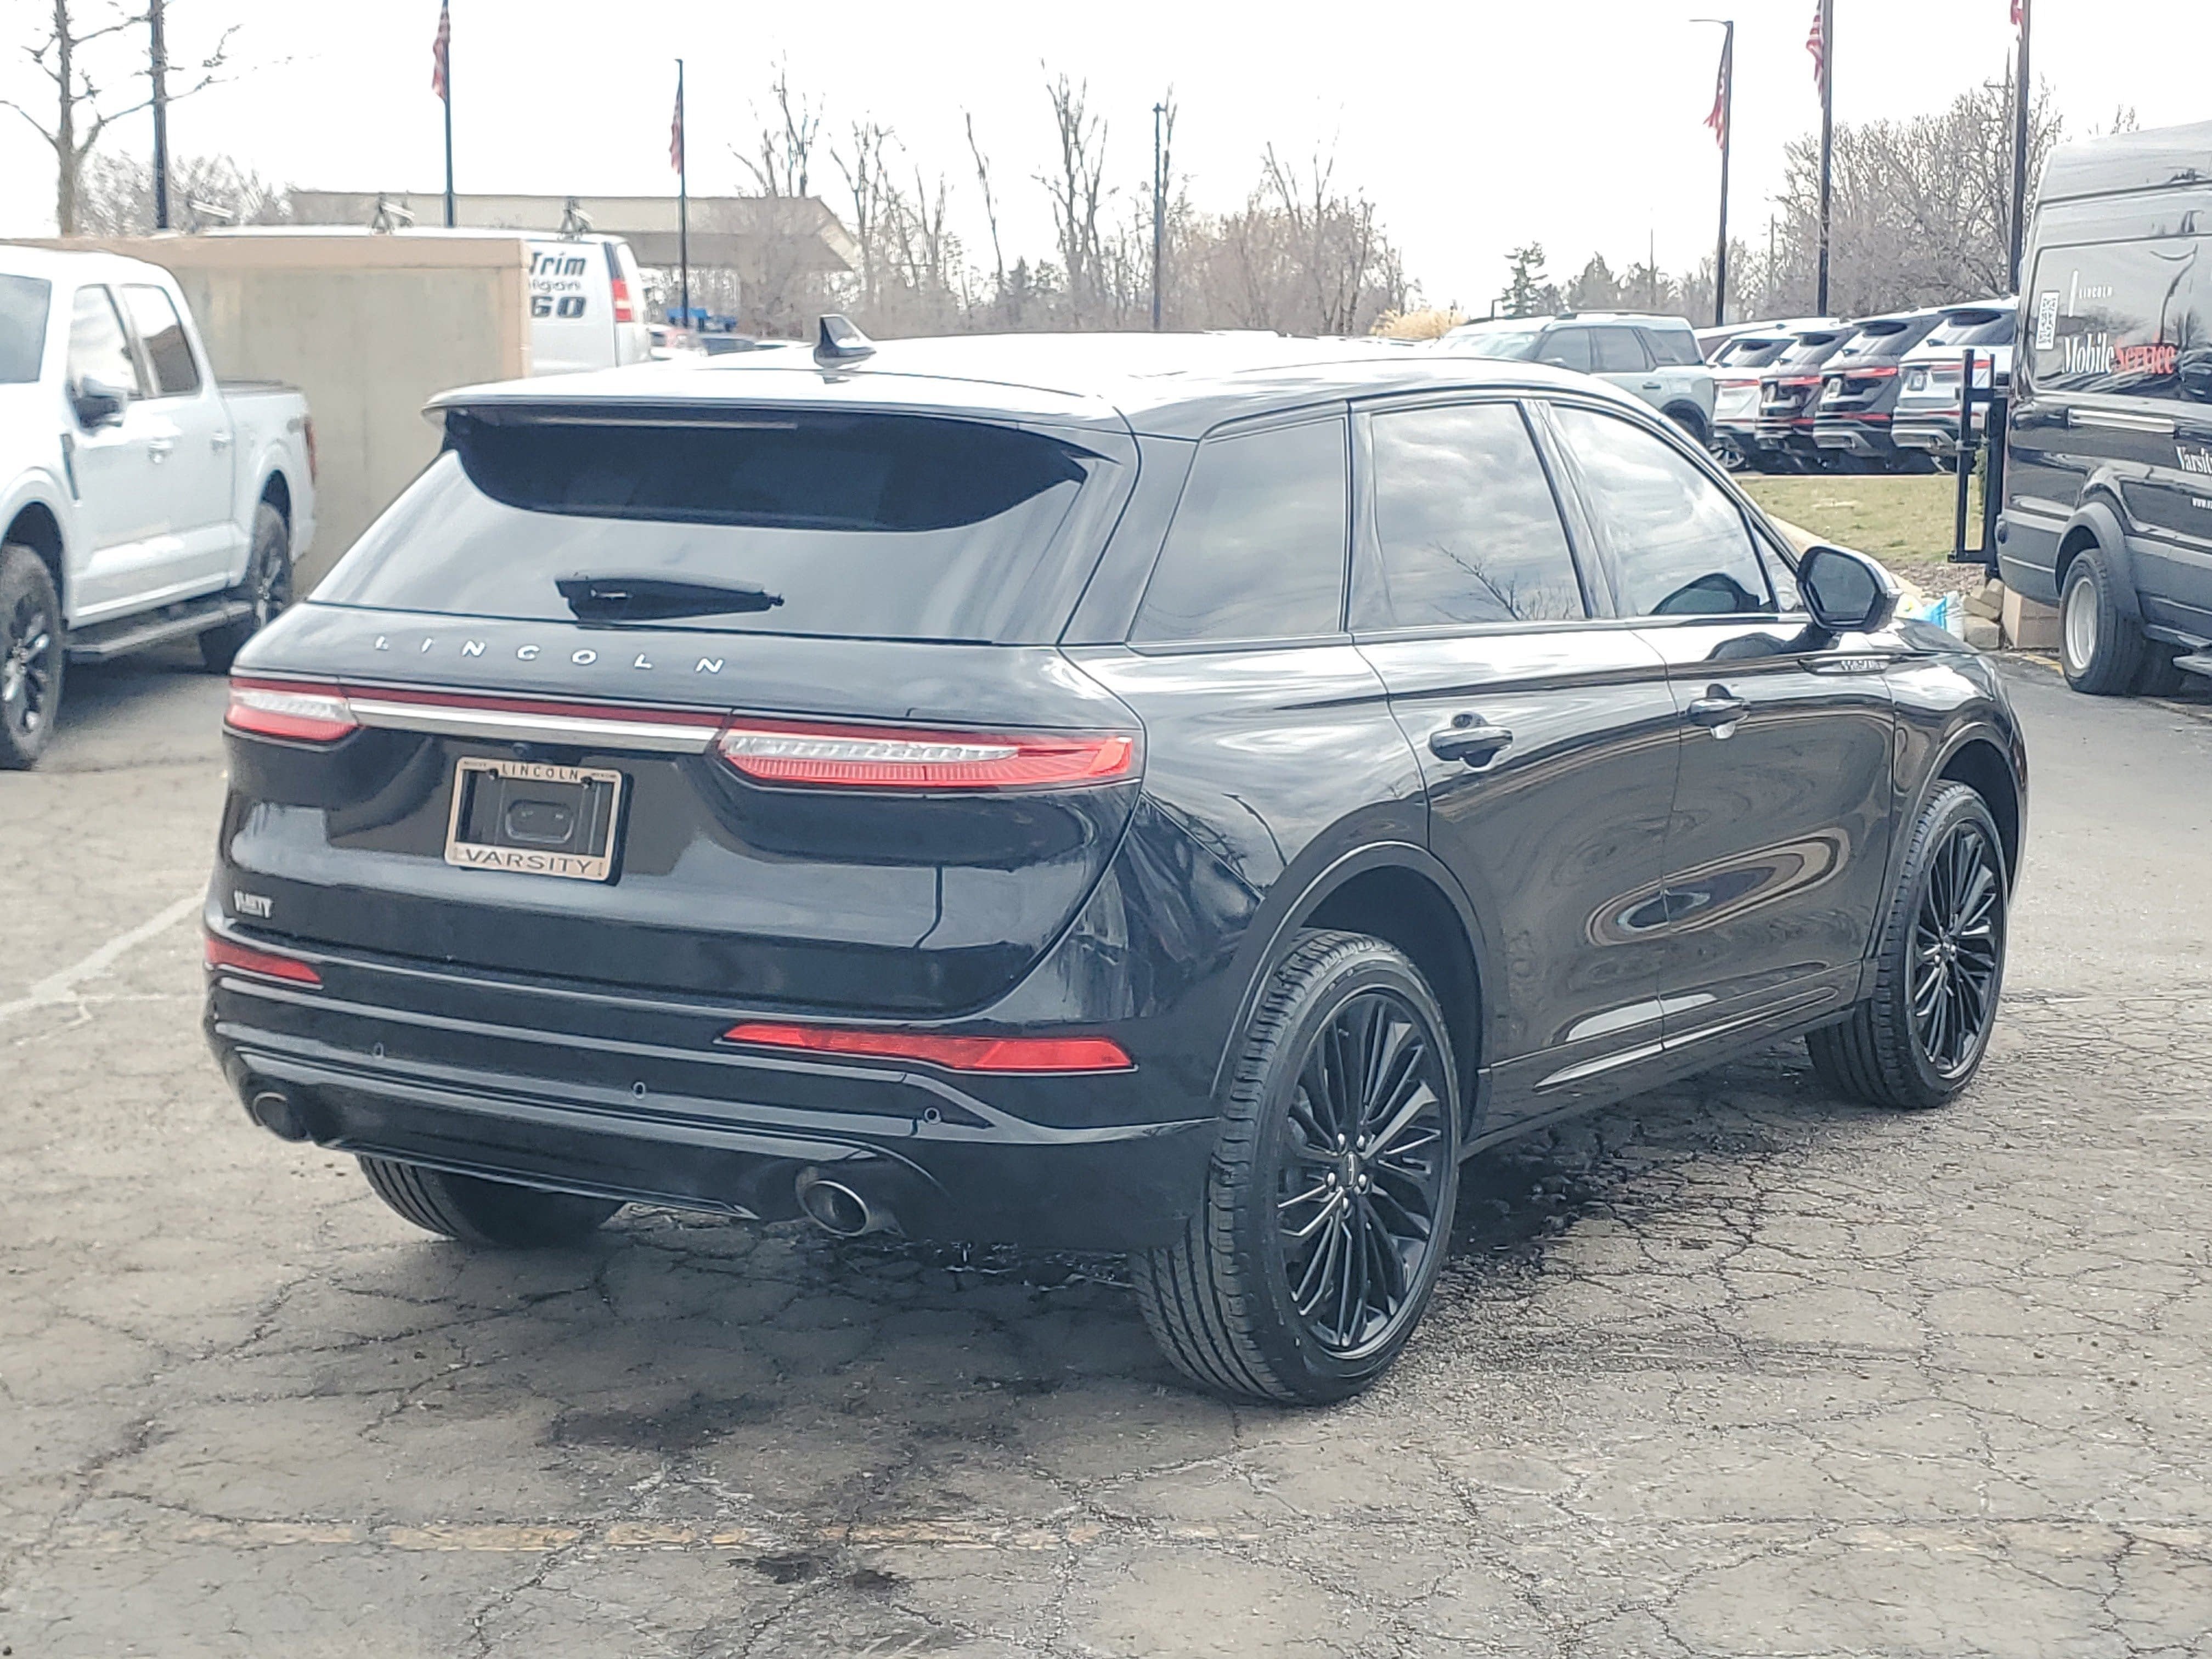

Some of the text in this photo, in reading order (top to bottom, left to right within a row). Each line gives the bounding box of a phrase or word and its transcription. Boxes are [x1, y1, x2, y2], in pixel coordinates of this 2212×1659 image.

[529, 251, 586, 275] Trim
[2062, 331, 2115, 374] Mobile
[374, 636, 724, 673] LINCOLN
[502, 763, 578, 780] LINCOLN
[466, 849, 592, 873] VARSITY
